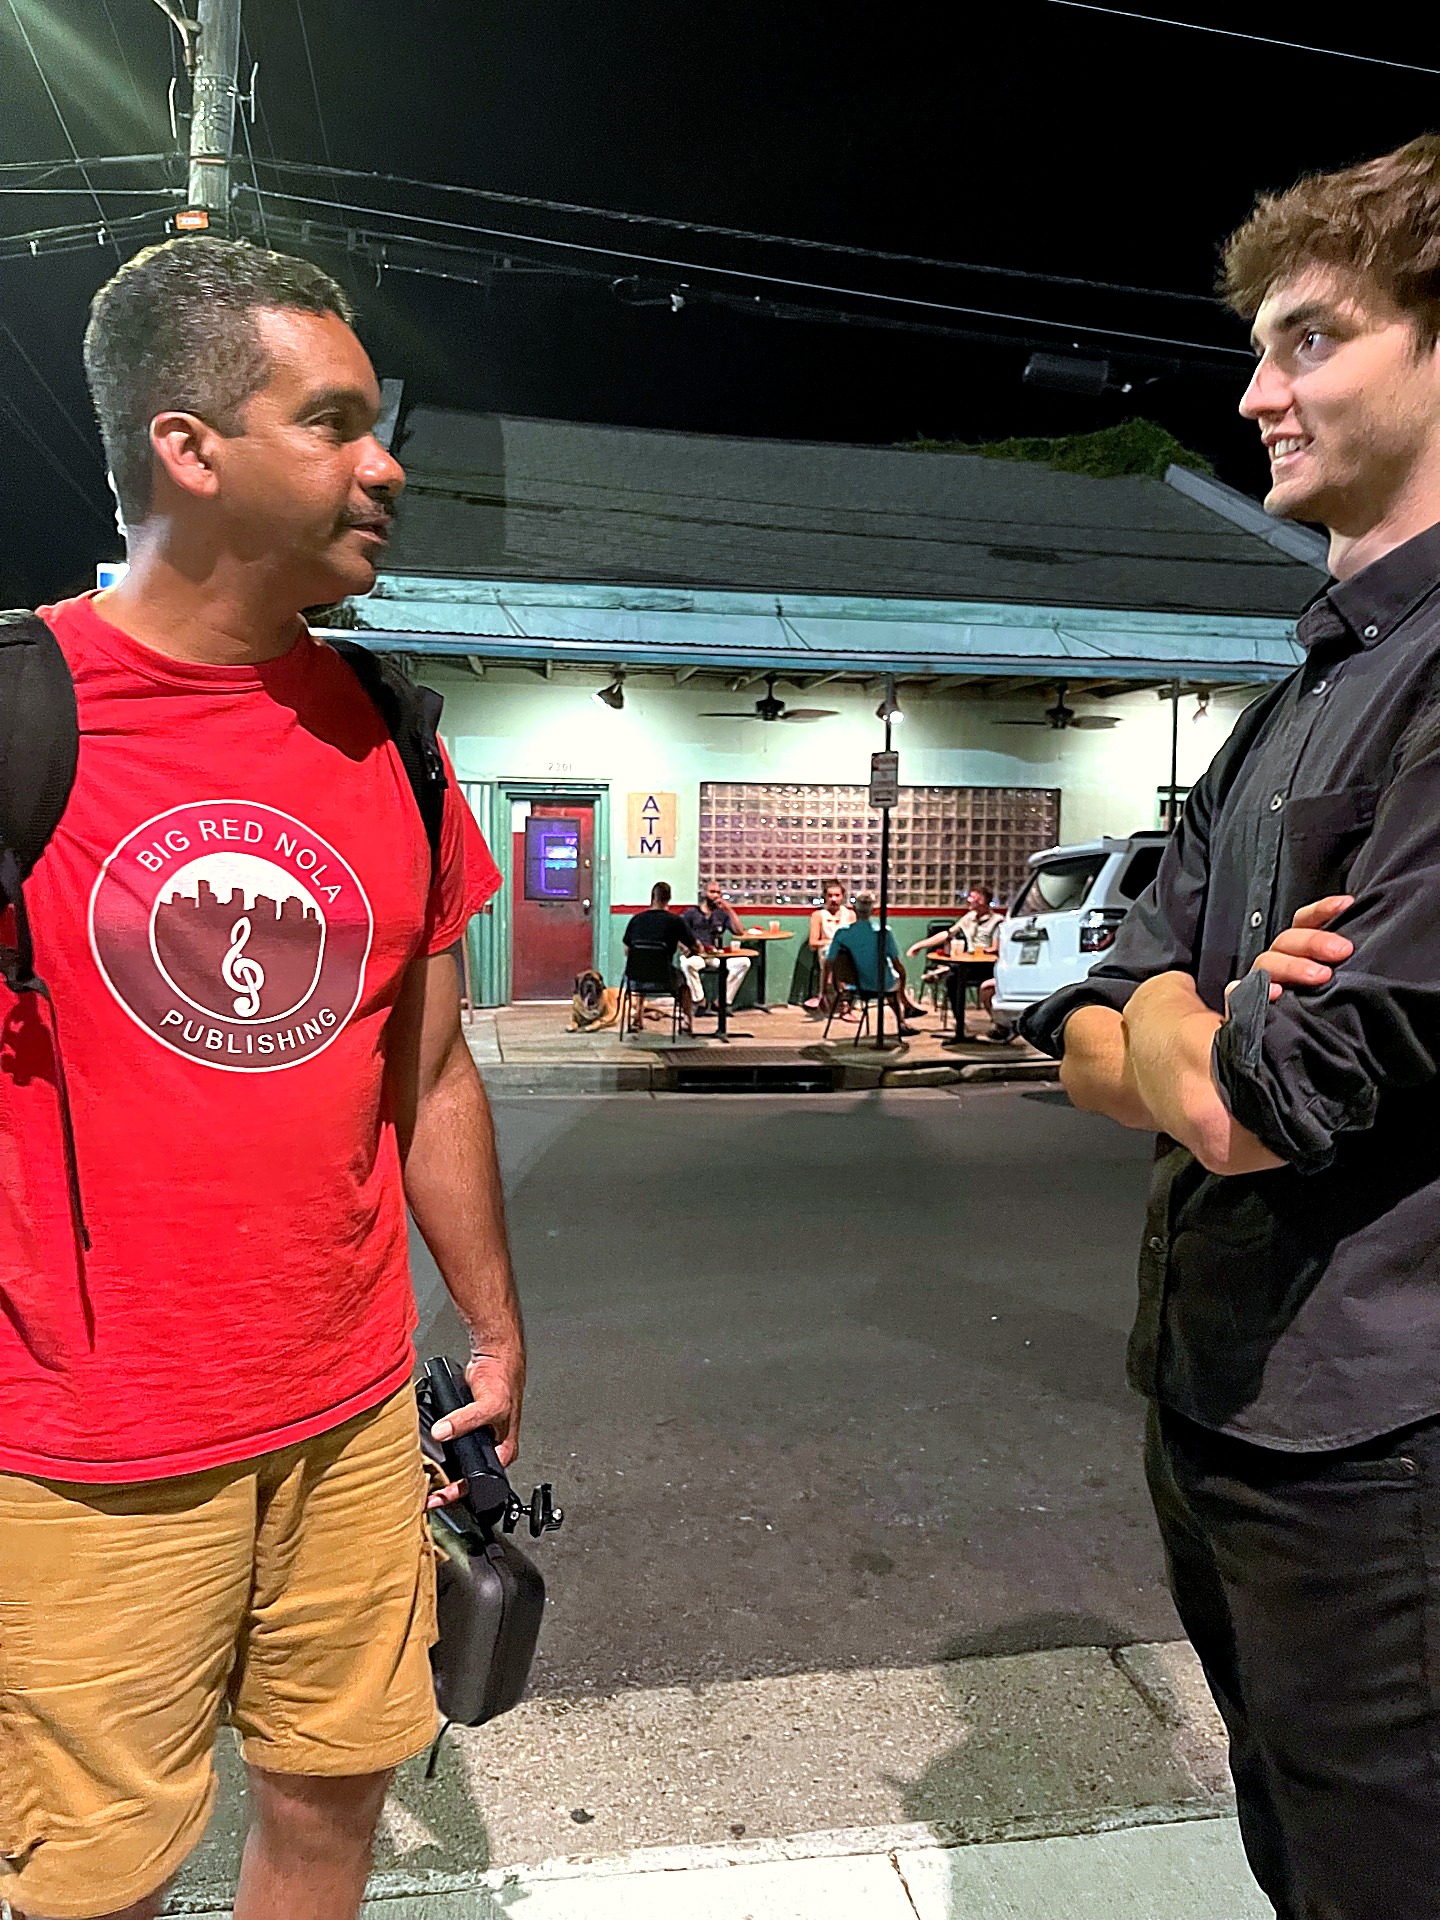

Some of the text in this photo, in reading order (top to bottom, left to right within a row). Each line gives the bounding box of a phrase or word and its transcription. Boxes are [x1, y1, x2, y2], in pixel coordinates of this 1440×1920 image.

[640, 795, 662, 855] ATM
[136, 818, 342, 904] BIG RED NOLA
[160, 1008, 337, 1054] PUBLISHING
